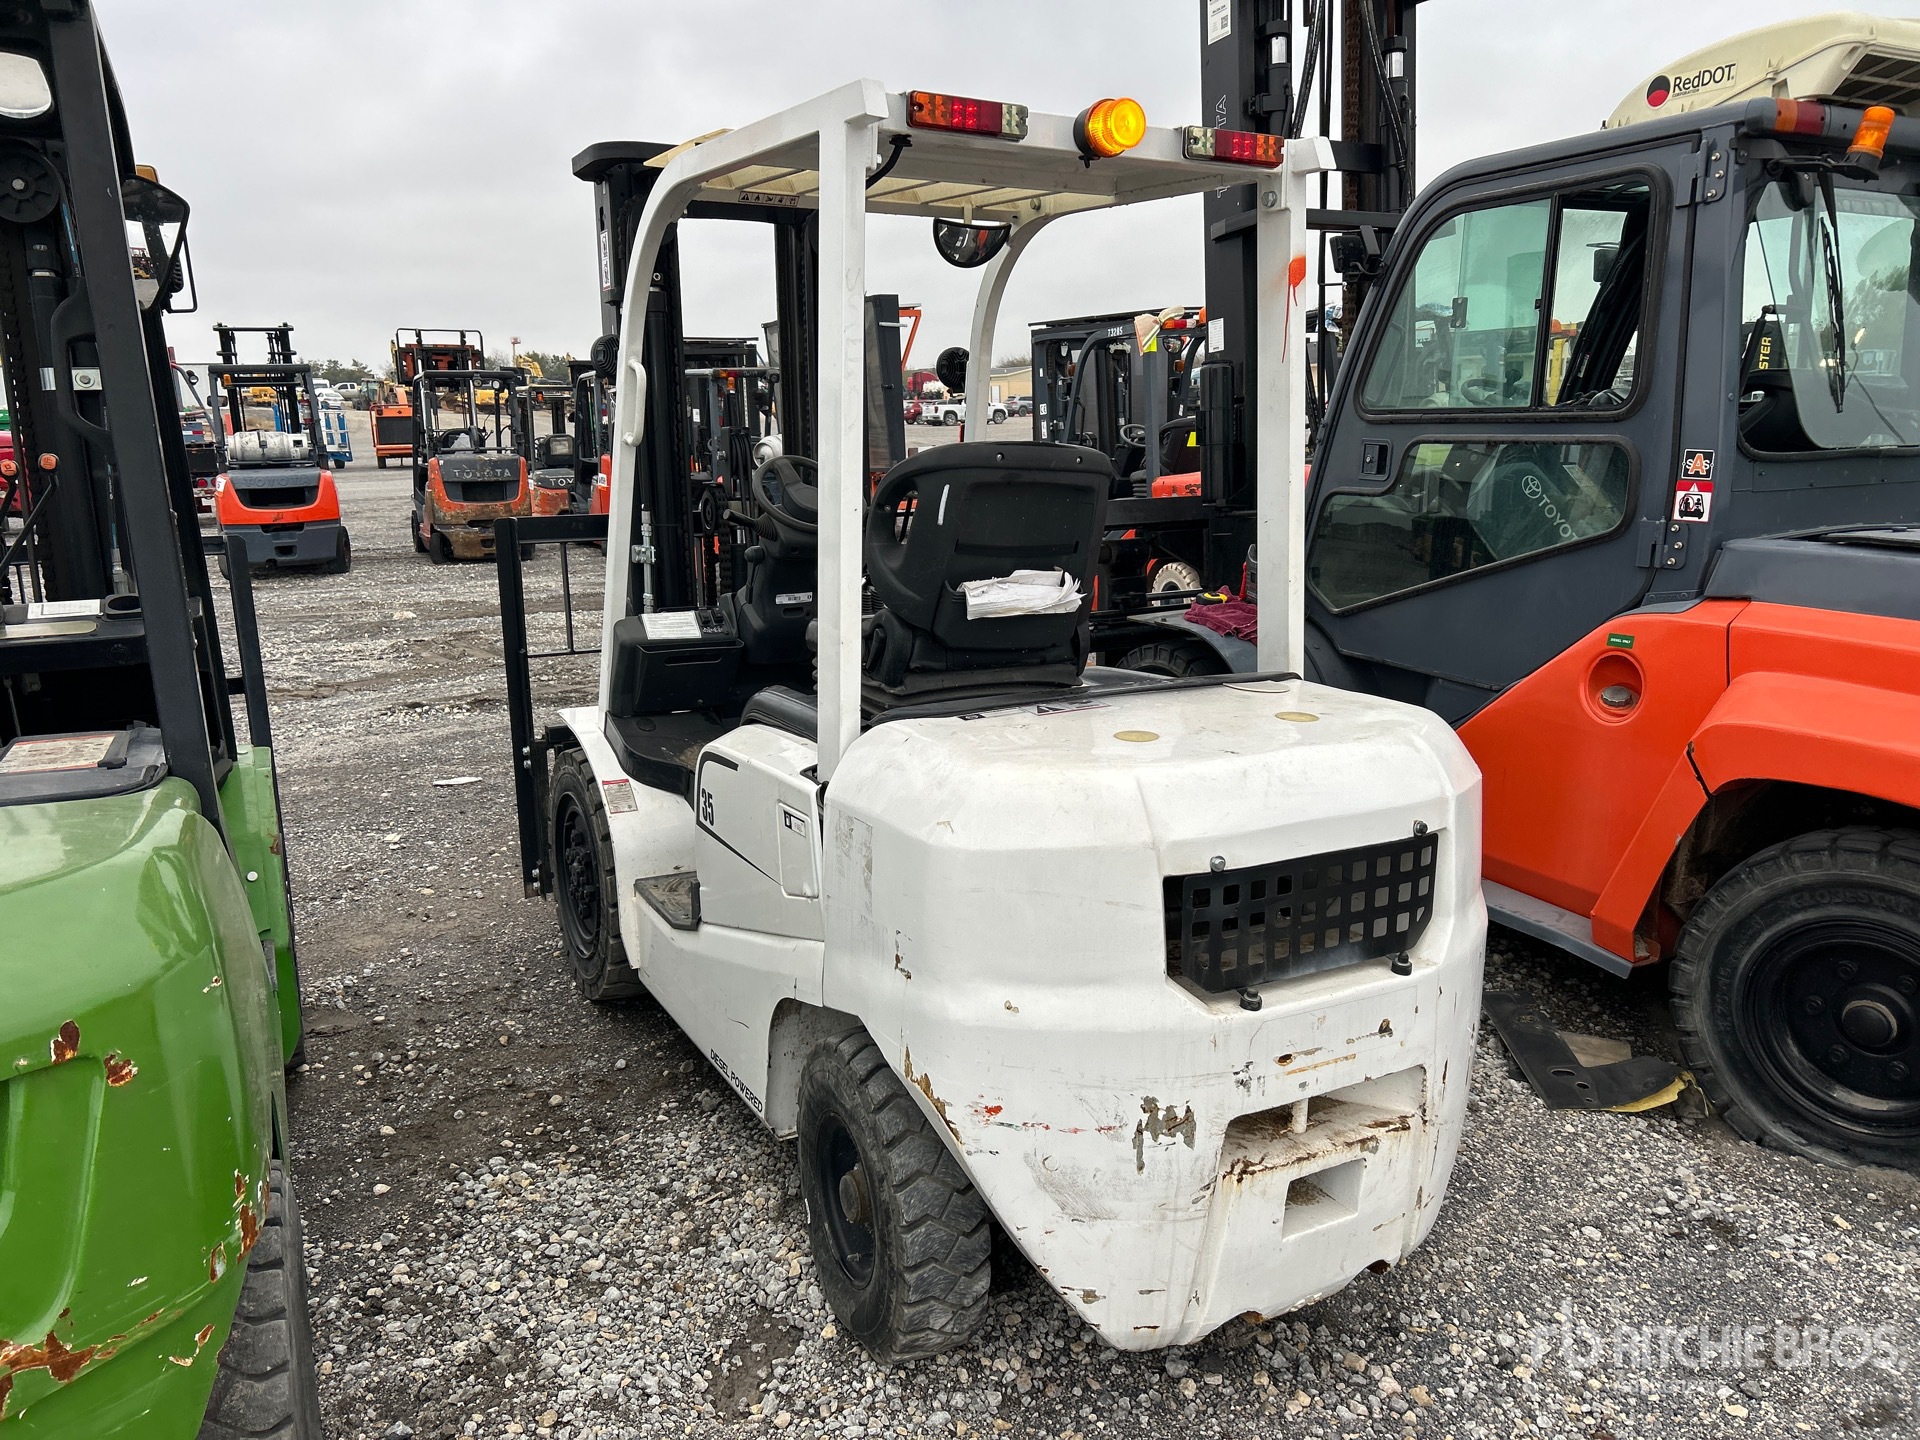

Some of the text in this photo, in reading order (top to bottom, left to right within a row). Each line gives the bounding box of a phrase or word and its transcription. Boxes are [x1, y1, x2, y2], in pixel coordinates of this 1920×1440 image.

[1672, 63, 1736, 93] RedDOT
[453, 468, 512, 480] TOYOTA
[1685, 453, 1711, 475] SAS
[243, 475, 312, 488] TOYOTA
[701, 787, 715, 827] 35
[710, 1048, 763, 1113] DIESEL POWERED
